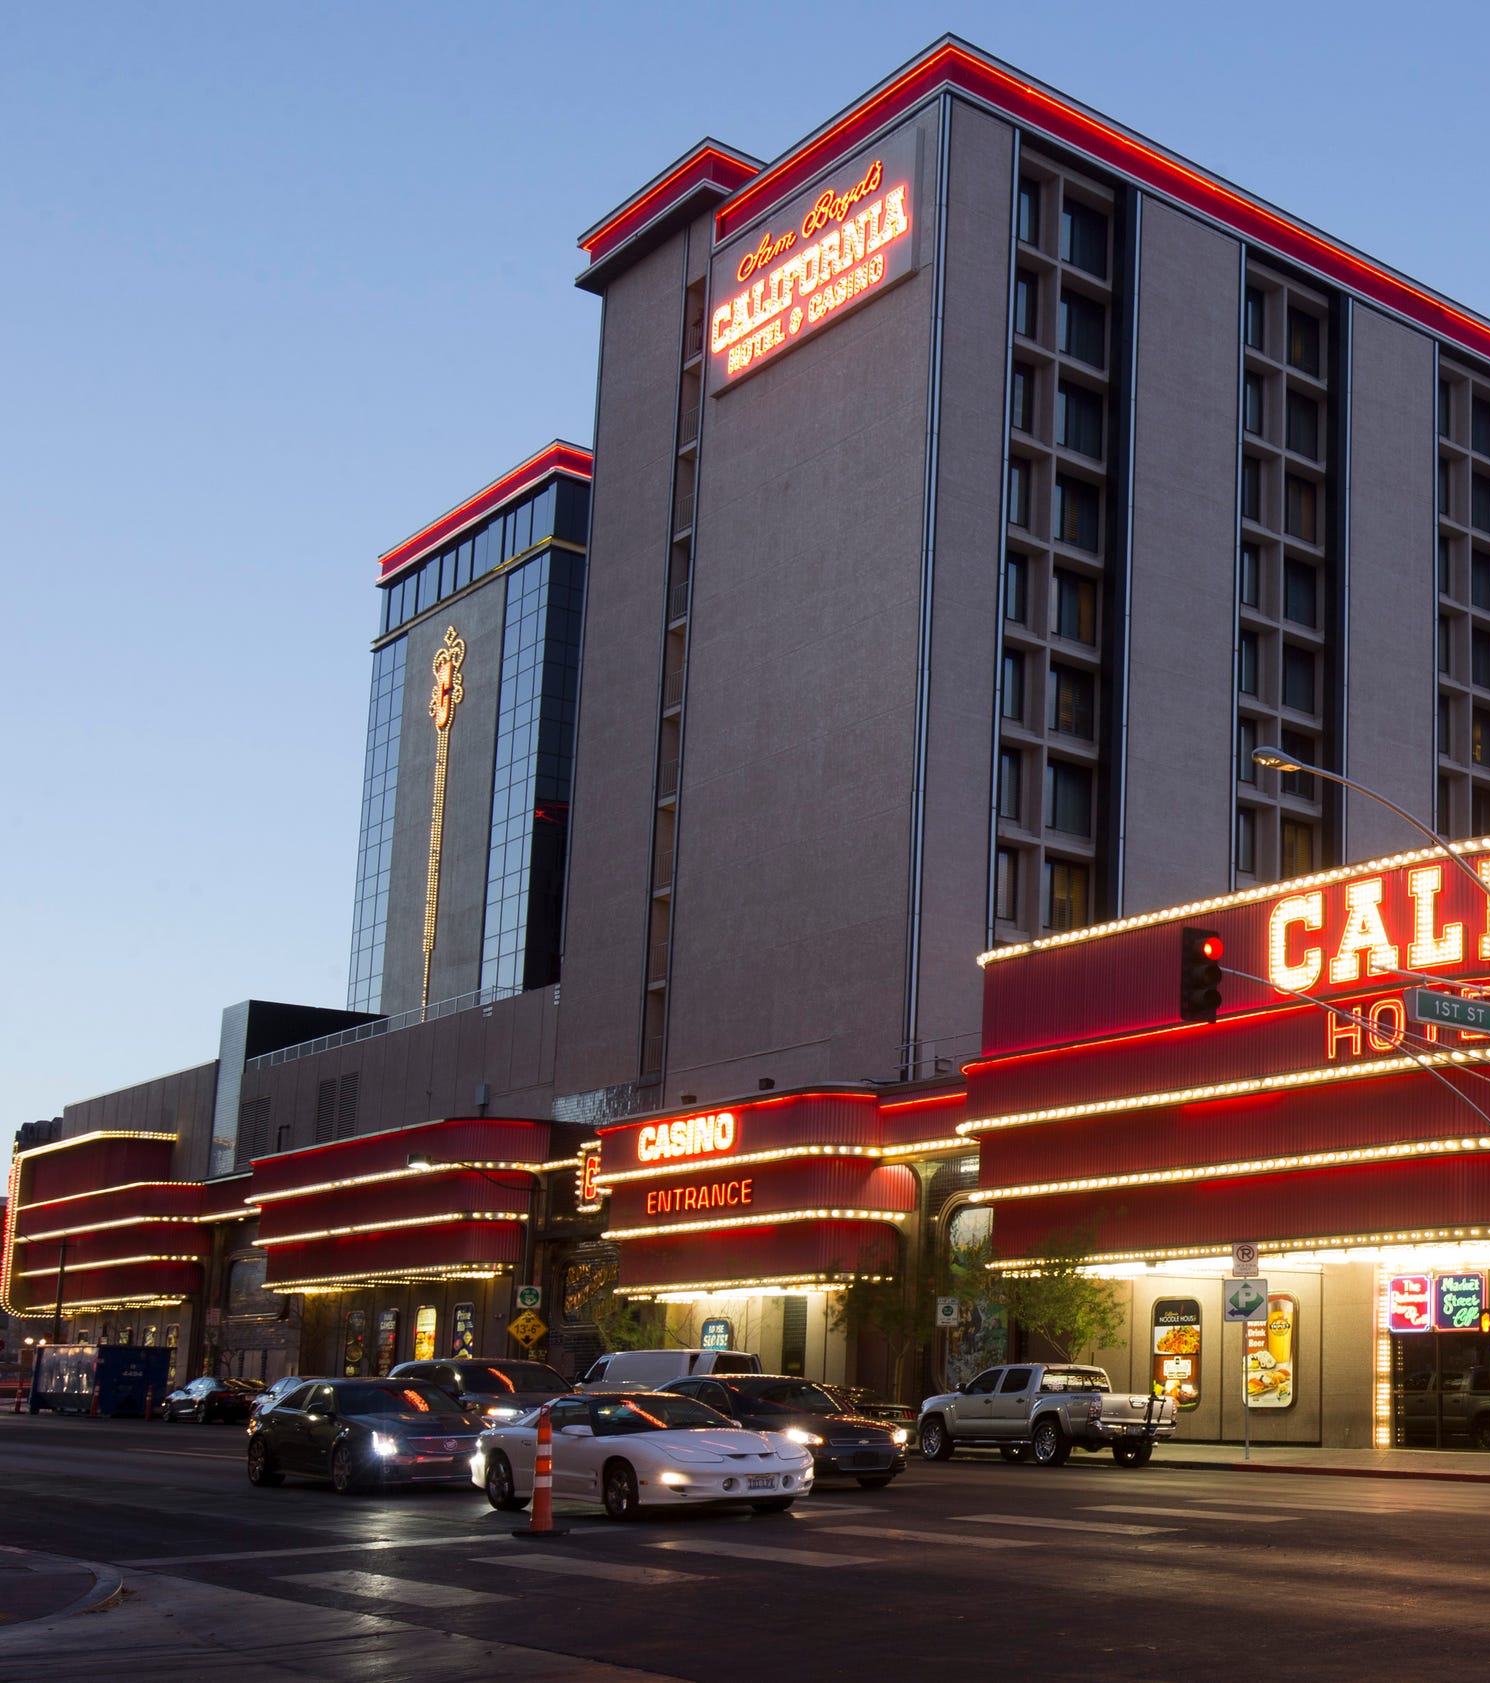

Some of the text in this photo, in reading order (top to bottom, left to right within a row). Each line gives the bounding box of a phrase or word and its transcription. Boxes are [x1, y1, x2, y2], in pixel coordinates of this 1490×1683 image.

[737, 160, 883, 282] Sam Boyd's
[711, 184, 909, 354] CALIFORNIA
[728, 253, 885, 375] HOTEL & CASINO
[1435, 1000, 1485, 1023] 1ST ST
[637, 1112, 735, 1162] CASINO
[647, 1179, 752, 1215] ENTRANCE
[1403, 1280, 1421, 1293] The
[1441, 1278, 1480, 1292] Market
[1443, 1293, 1480, 1315] Street
[1159, 1315, 1180, 1323] NOODLE
[1247, 1328, 1266, 1338] Drink
[1248, 1338, 1265, 1348] Beer
